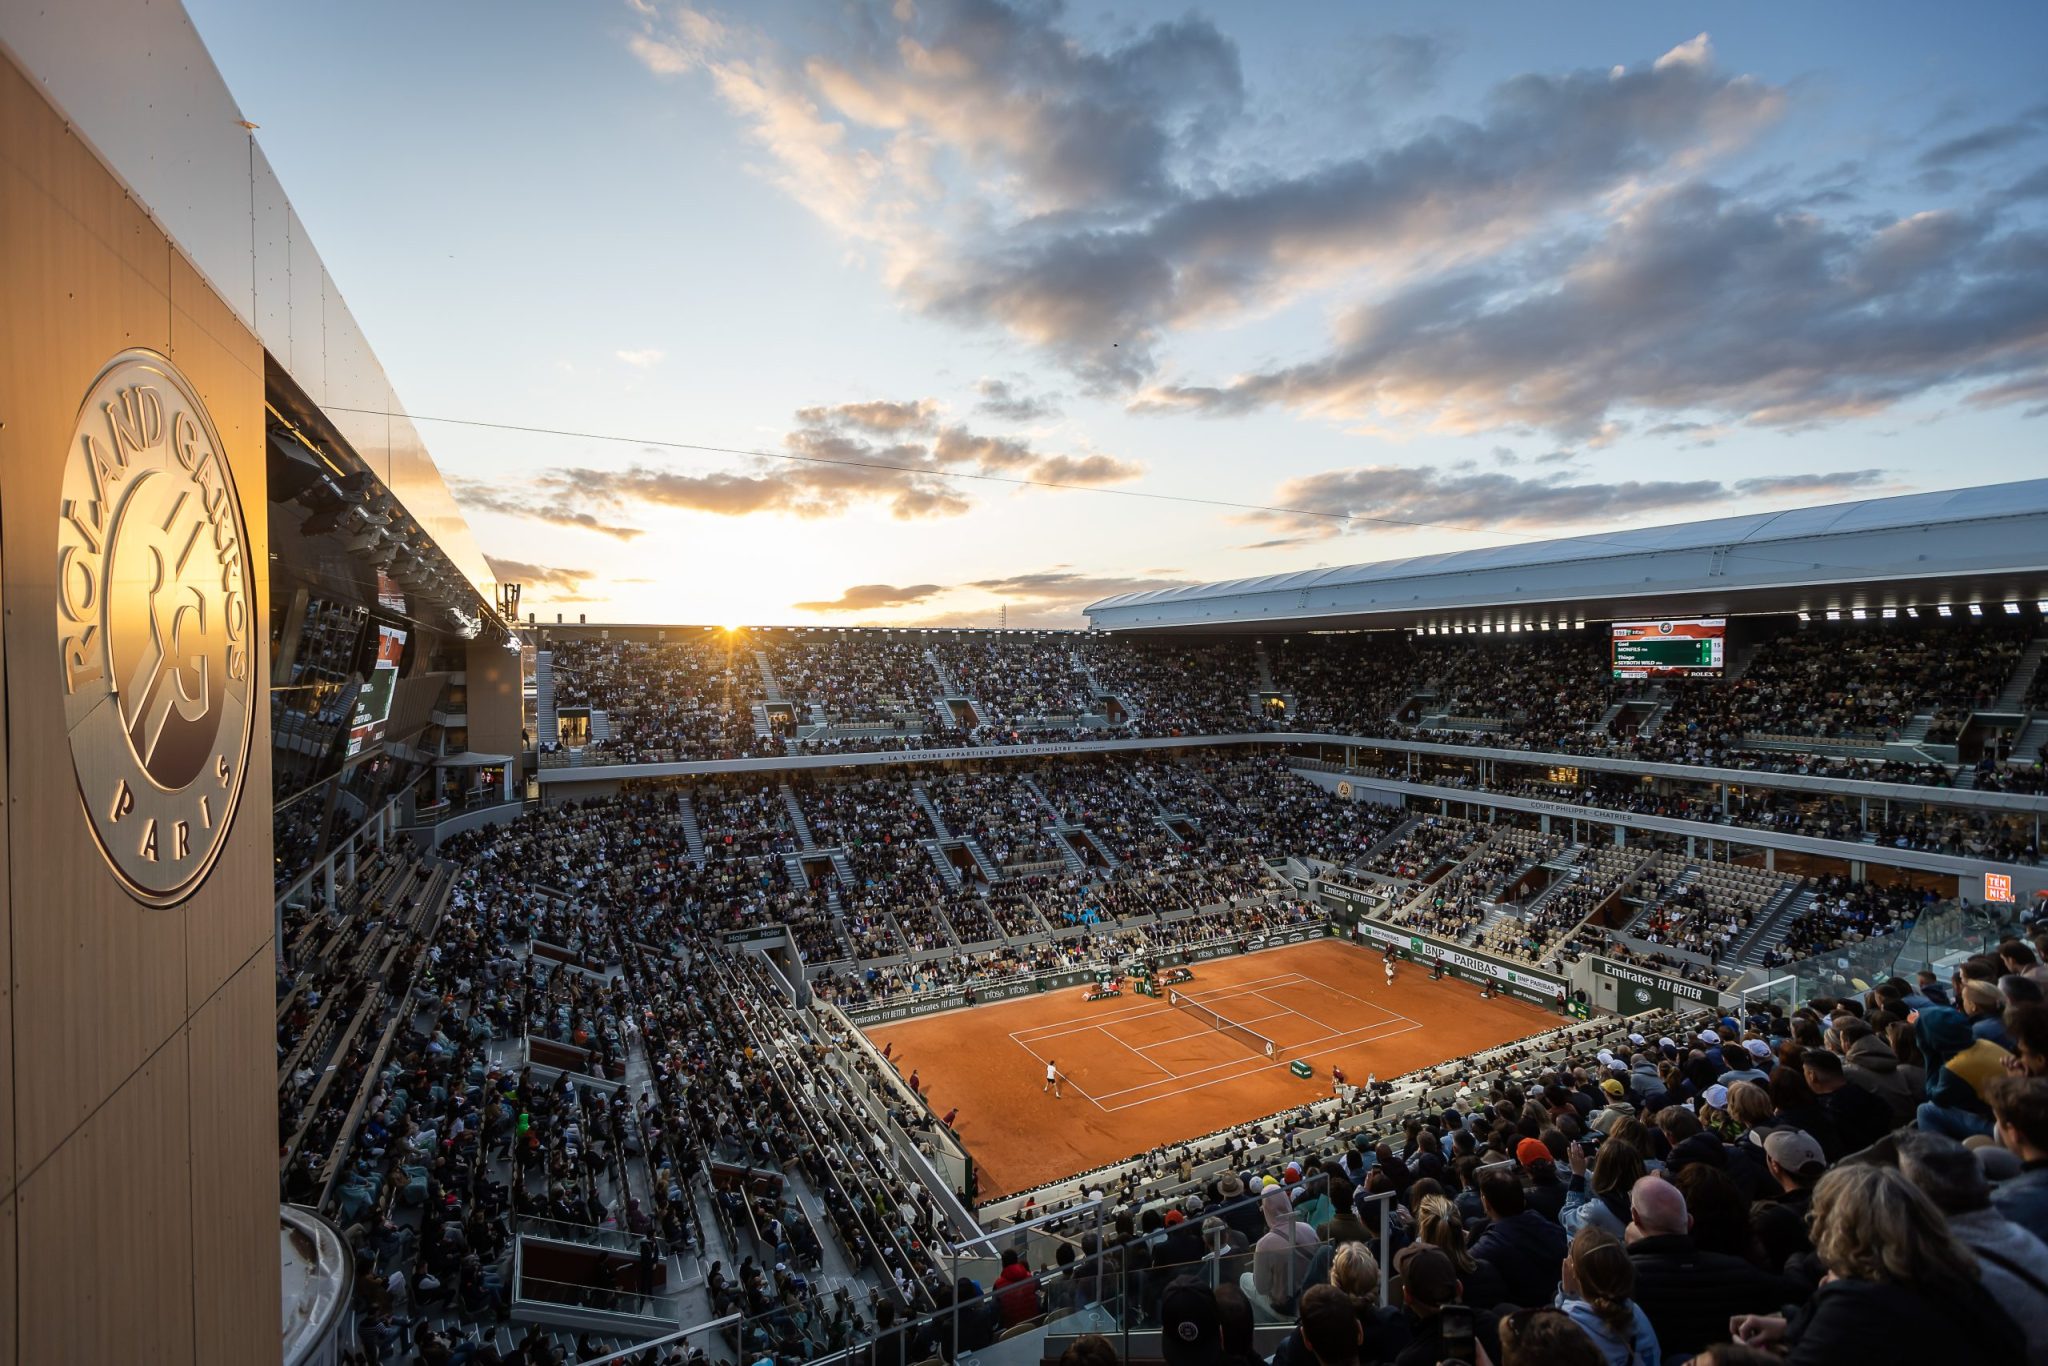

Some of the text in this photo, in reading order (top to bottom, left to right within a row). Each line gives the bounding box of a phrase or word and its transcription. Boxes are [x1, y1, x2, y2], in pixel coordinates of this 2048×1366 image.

[61, 385, 248, 695] ROLAND GARROS
[945, 750, 995, 758] APPARTIENT
[1031, 745, 1072, 753] OPINIÂTRE
[108, 754, 231, 862] PARIS
[1530, 801, 1555, 810] COURT
[1988, 877, 2006, 887] TEN
[1323, 884, 1376, 907] Emirates FLY BETTER
[1990, 889, 2006, 899] NIS
[728, 929, 781, 942] Haier Haier
[1381, 931, 1400, 942] PARIBAS
[1424, 944, 1498, 976] BNP PARIBAS
[1517, 974, 1530, 983] BNP
[1530, 978, 1555, 992] PARIBAS
[1603, 962, 1654, 987] Emirates
[1658, 978, 1672, 992] FLY
[1672, 983, 1702, 1000] BETTER
[984, 985, 1030, 1000] Infosys Infosys
[1512, 989, 1544, 1004] BNP PARIBAS
[882, 1011, 891, 1020] FLY
[890, 1008, 907, 1019] BETTER
[910, 1003, 940, 1014] Emirates
[940, 999, 949, 1009] FLY
[948, 997, 964, 1007] BETTER
